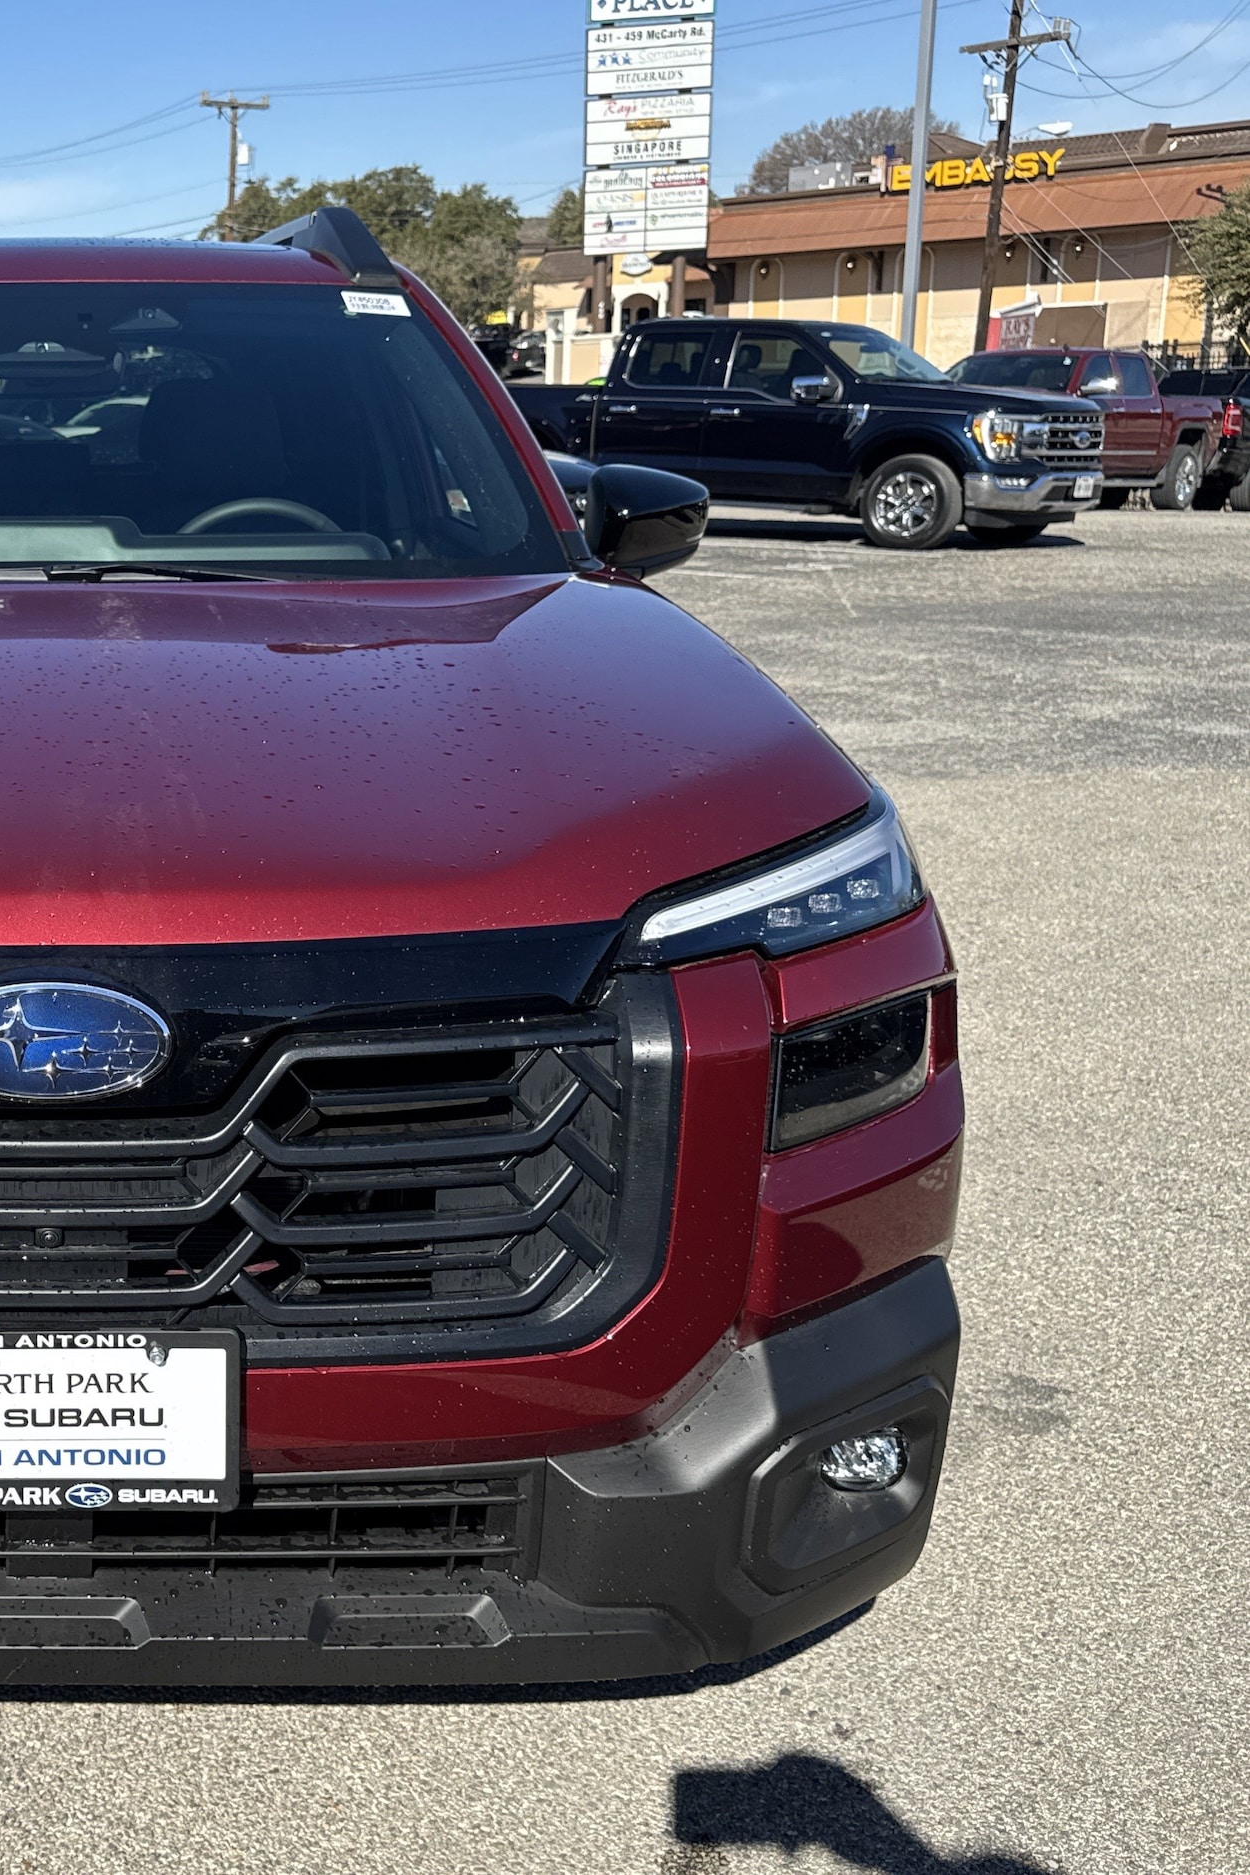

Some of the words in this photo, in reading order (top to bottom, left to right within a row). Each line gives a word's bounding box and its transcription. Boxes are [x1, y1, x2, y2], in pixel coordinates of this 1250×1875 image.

[595, 33, 613, 43] 431
[624, 31, 643, 41] 459
[646, 29, 687, 40] McCarty
[616, 70, 683, 84] FITZGERALD'S
[613, 140, 682, 155] SINGAPORE
[15, 1334, 147, 1348] ANTONIO
[67, 1371, 154, 1393] PARK
[14, 1448, 166, 1466] ANTONIO
